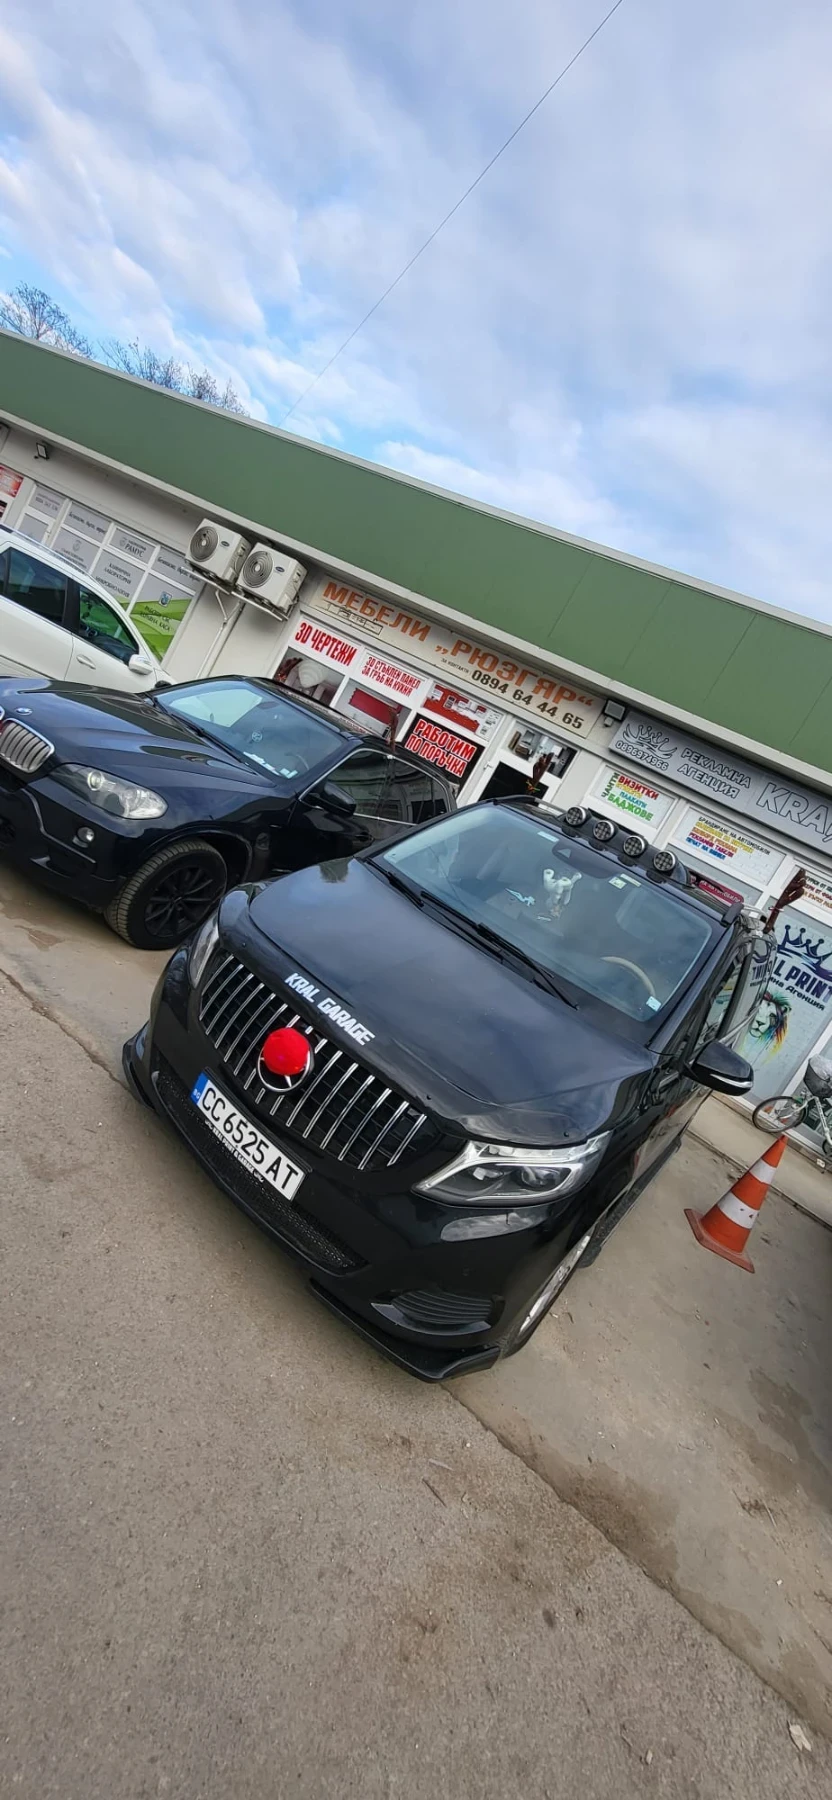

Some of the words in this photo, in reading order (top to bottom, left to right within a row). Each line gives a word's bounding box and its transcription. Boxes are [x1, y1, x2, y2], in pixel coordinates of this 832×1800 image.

[323, 582, 431, 642] МЕБЕЛИ
[295, 622, 311, 644] 3D
[311, 628, 357, 666] ЧЕРТЕЖИ
[362, 666, 372, 676] ЗА
[371, 670, 386, 684] ГРЪБ
[384, 677, 394, 688] НА
[392, 680, 414, 697] КУХНЯ
[366, 656, 376, 667] 3D
[374, 660, 401, 680] СТЪКЛЕН
[400, 672, 421, 689] ПАНЕЛ
[471, 670, 508, 694] 0894
[512, 689, 534, 705] 64
[536, 702, 558, 716] 44
[562, 712, 584, 729] 65
[405, 735, 425, 754] ПО
[421, 742, 468, 778] ПОРЪЧКА
[414, 719, 477, 760] РАБОТИМ
[615, 741, 669, 771] 0896974966
[601, 772, 620, 797] ЧАНТИ
[677, 764, 740, 799] АГЕНЦИЯ
[681, 748, 751, 788] РЕКЛАМНА
[618, 776, 659, 800] ВИЗИТКИ
[620, 792, 647, 808] ПЛАКАТИ
[608, 793, 654, 821] БАДЖОВЕ
[715, 845, 734, 857] ТАБЕЛИ
[738, 836, 770, 855] АВТОМОБИЛИ
[285, 973, 321, 1002] KRAL
[317, 997, 375, 1045] GARAGE
[202, 1087, 226, 1122] CC
[223, 1112, 269, 1165] 6525
[265, 1156, 298, 1190] AT
